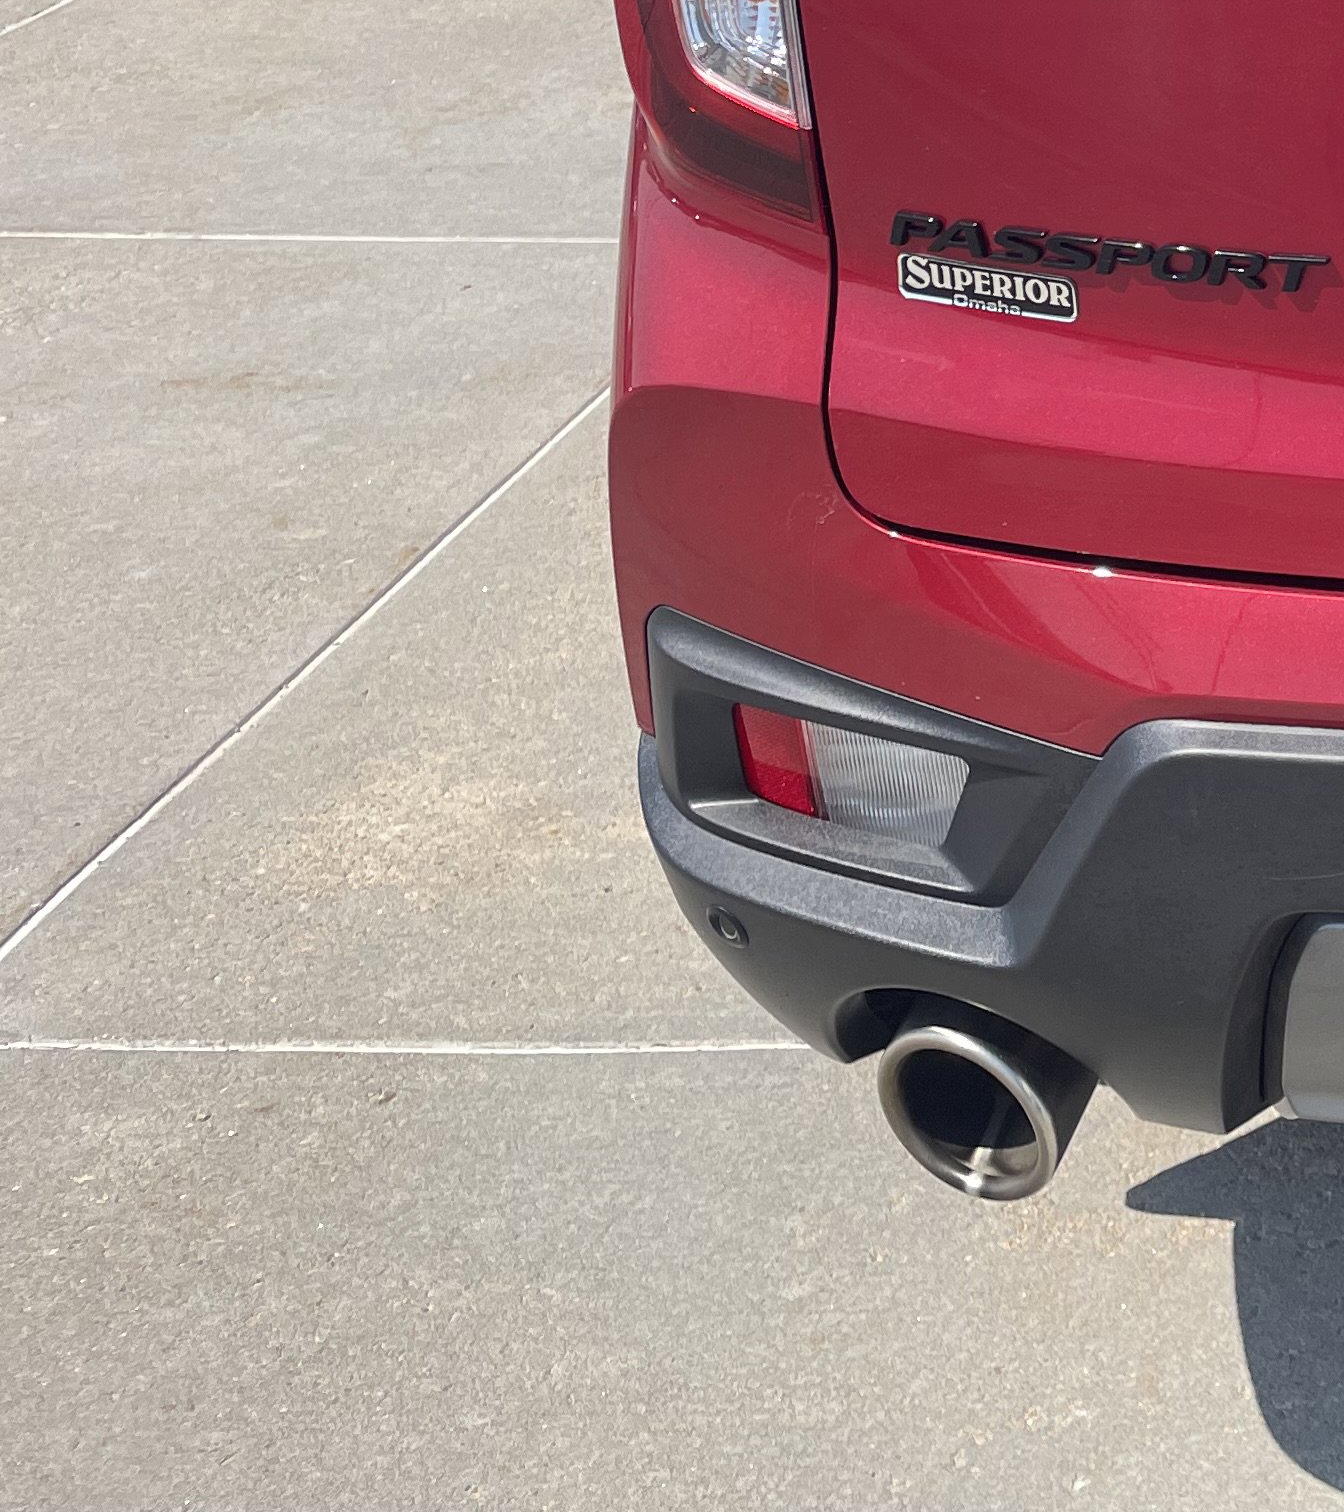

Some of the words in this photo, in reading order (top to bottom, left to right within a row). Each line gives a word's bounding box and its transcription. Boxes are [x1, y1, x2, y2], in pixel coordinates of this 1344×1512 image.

[889, 209, 1331, 294] PASSPORT
[904, 255, 1072, 309] SUPERIOR
[952, 292, 1023, 317] Omaha
